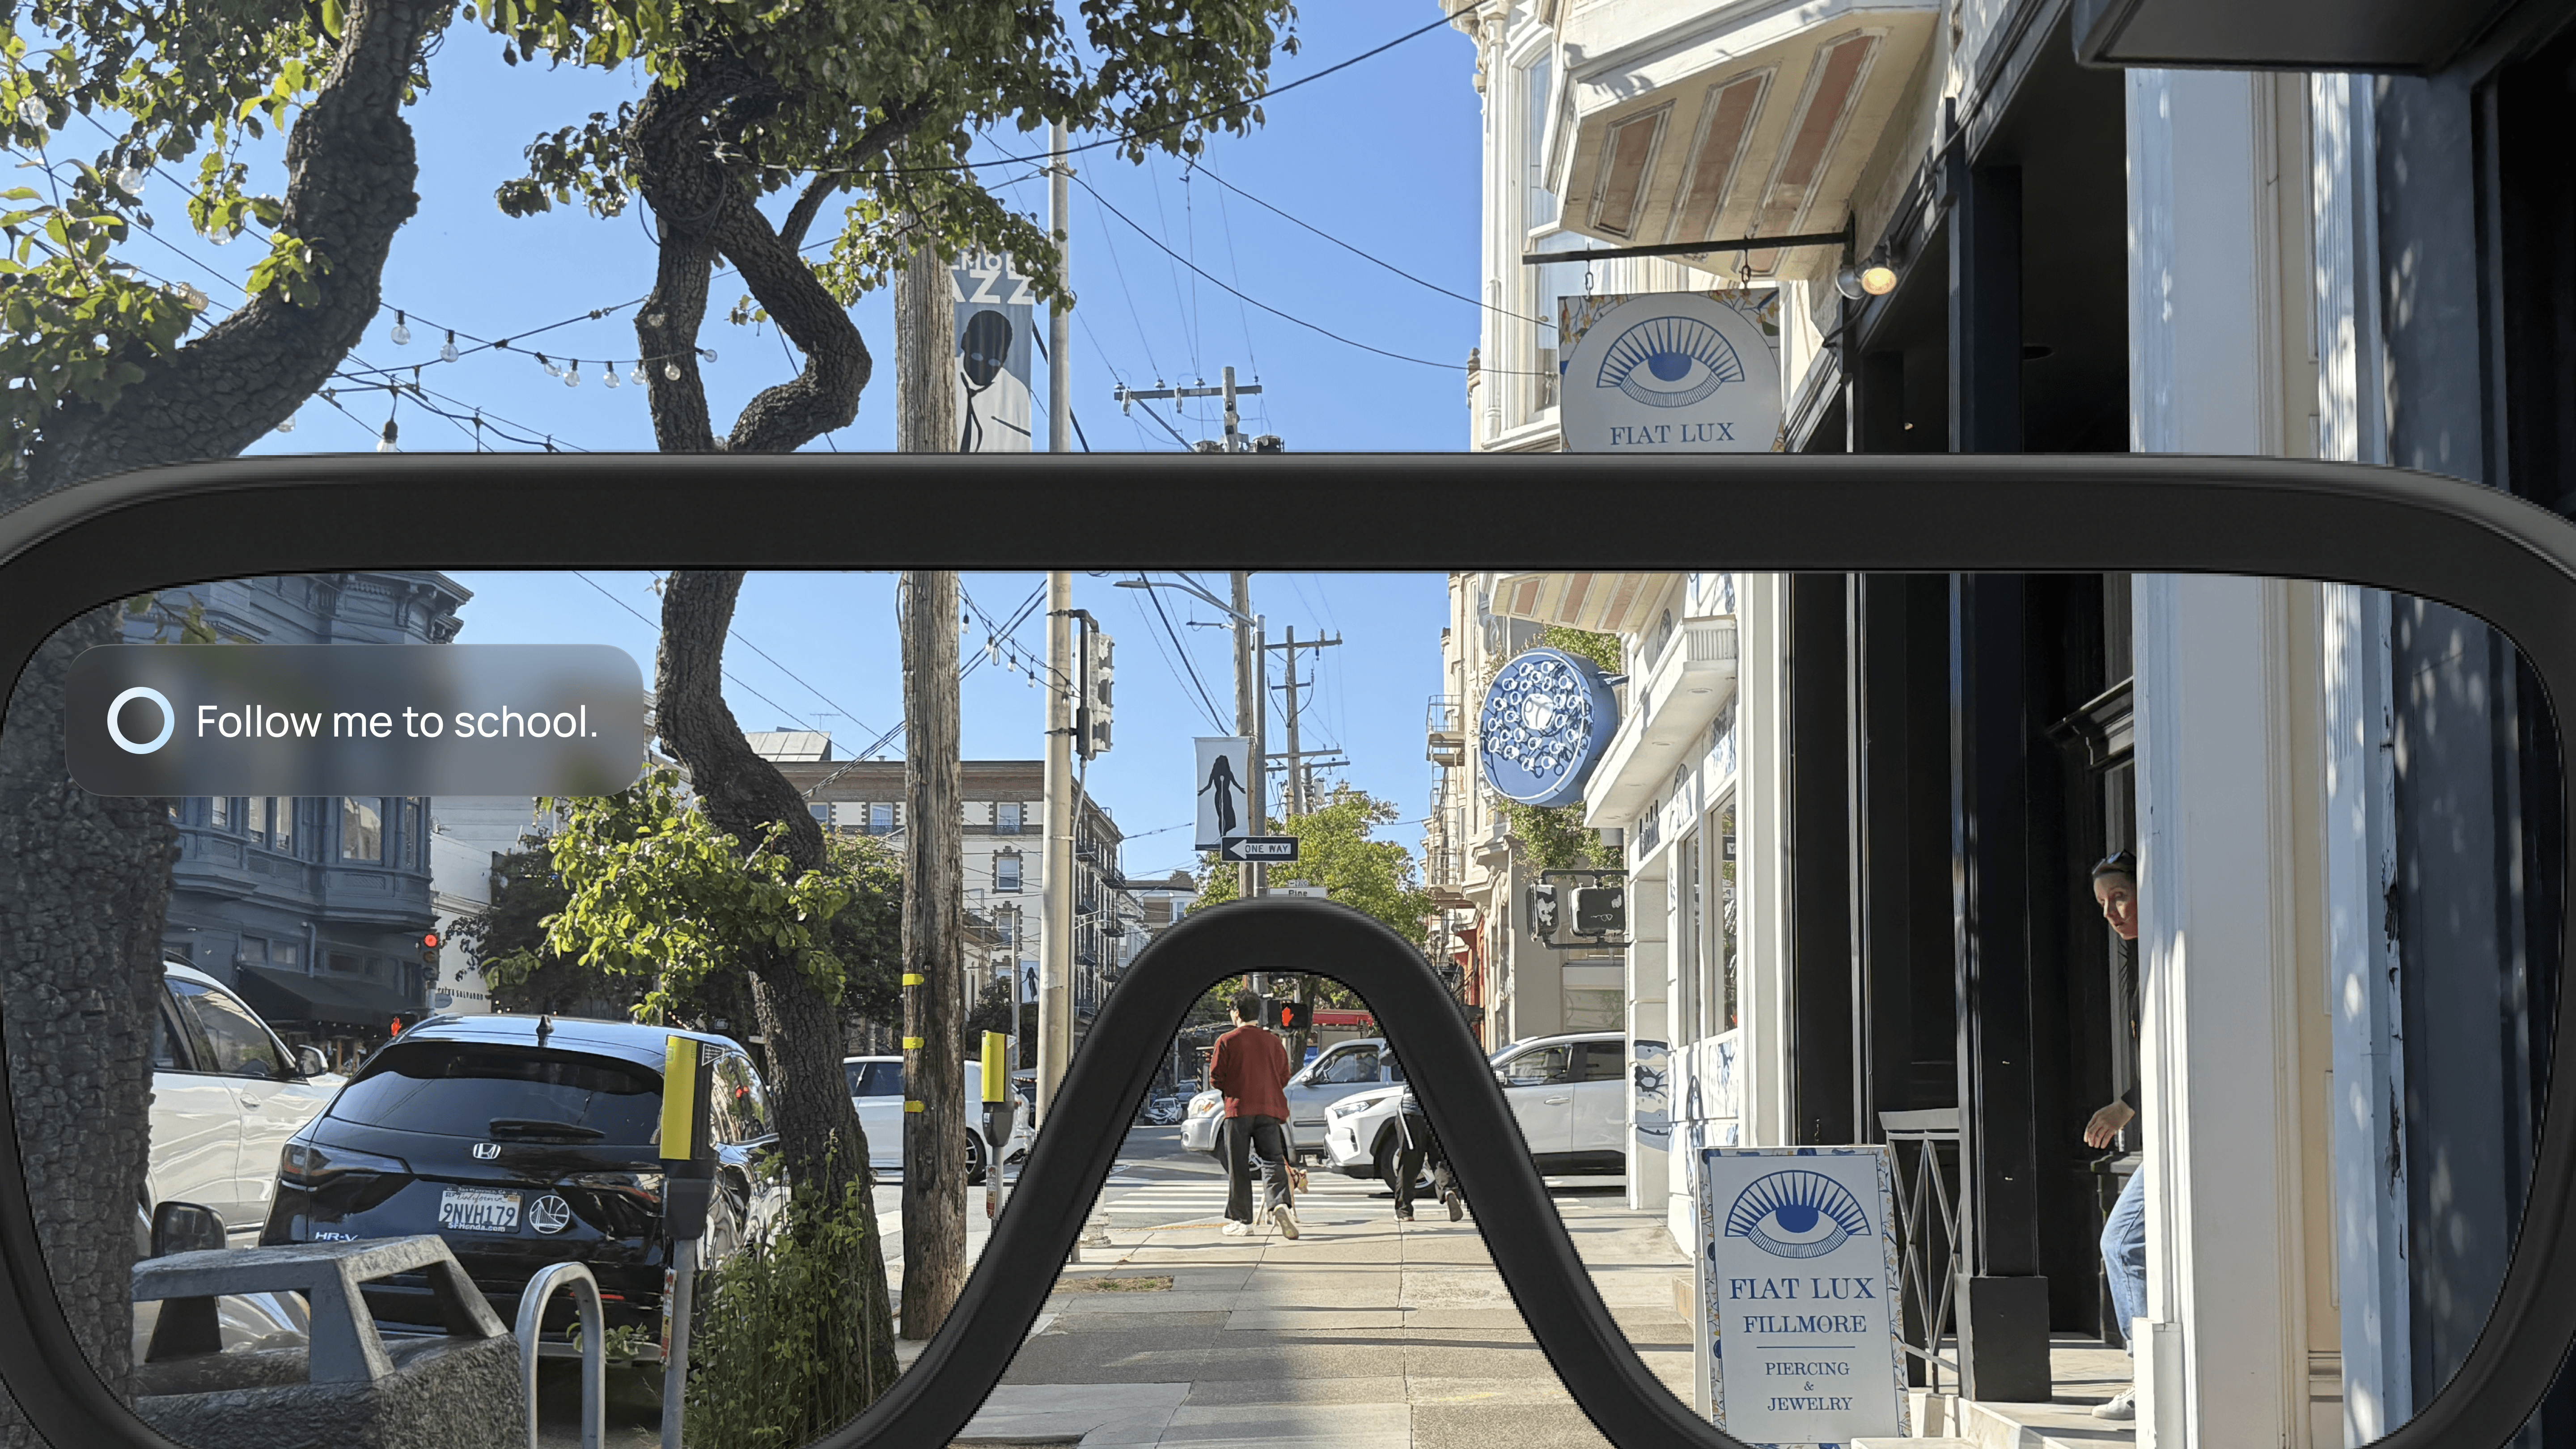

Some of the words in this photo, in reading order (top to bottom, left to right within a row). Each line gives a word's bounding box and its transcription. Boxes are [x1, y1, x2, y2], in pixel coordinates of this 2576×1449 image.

[1610, 425, 1671, 445] FIAT
[1680, 422, 1735, 442] LUX
[1245, 844, 1264, 853] ONE
[1269, 844, 1288, 853] WAY
[441, 1203, 516, 1226] 9NVH179
[315, 1232, 358, 1241] HR-V
[1728, 1278, 1800, 1299] FIAT
[1809, 1278, 1877, 1299] LUX
[1743, 1315, 1867, 1333] FILLMORE
[1765, 1362, 1850, 1376] PIERCING
[1804, 1381, 1814, 1391] &
[1767, 1397, 1853, 1411] JEWELRY
